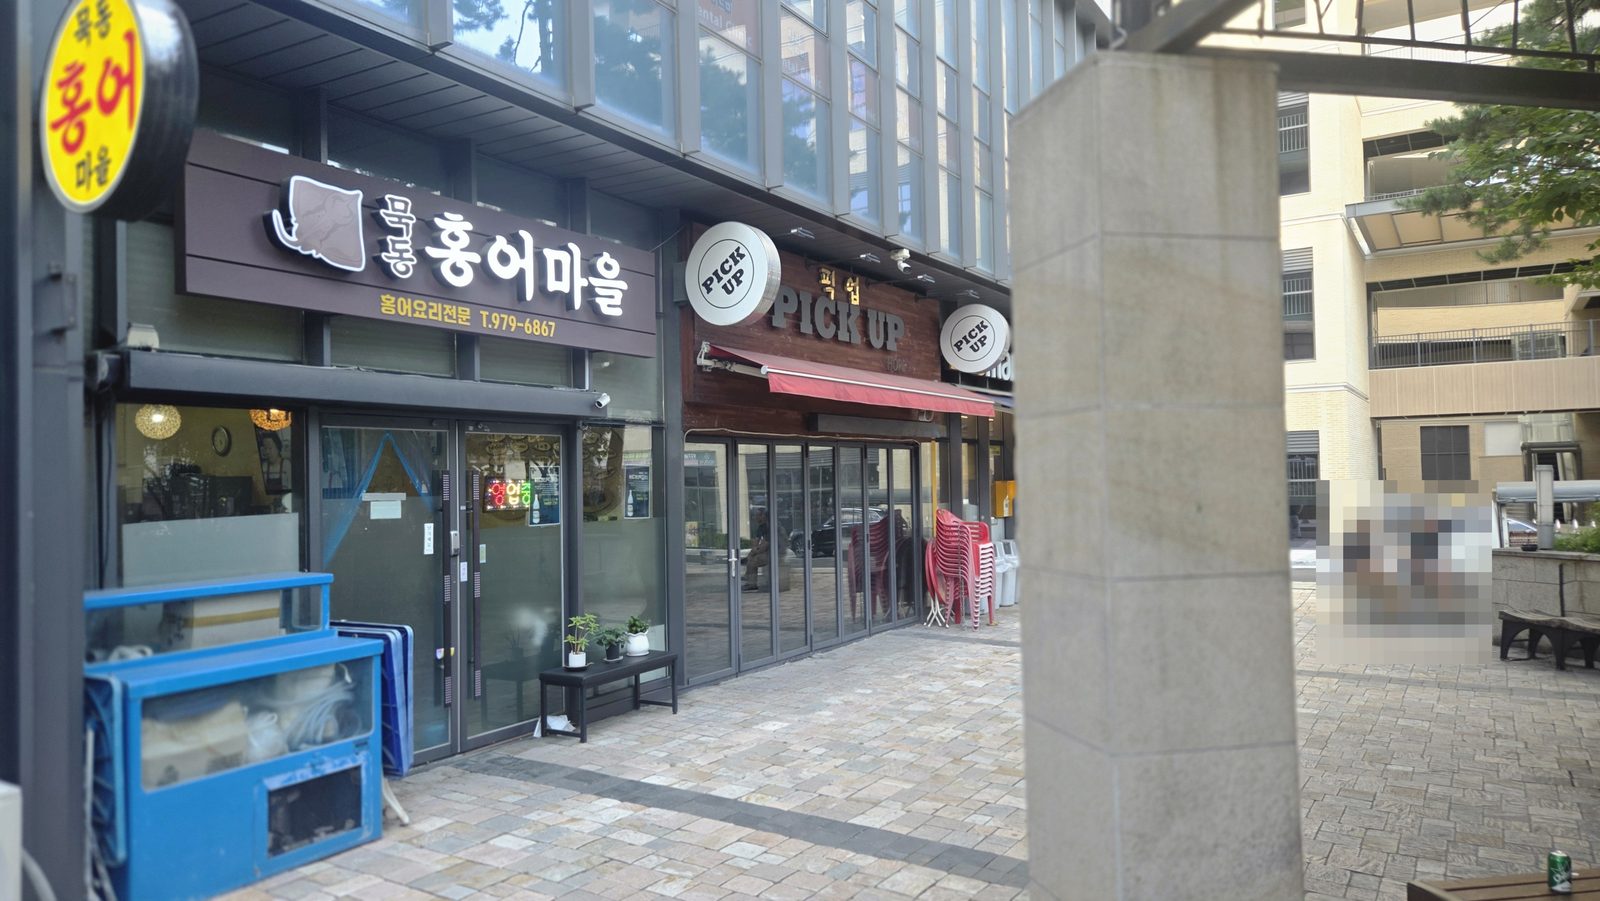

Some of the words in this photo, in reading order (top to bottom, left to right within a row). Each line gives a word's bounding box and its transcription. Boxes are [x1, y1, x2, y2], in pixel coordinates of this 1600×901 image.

[50, 28, 135, 155] 홍어
[75, 145, 111, 191] 마을
[379, 193, 417, 279] 묵동
[424, 211, 629, 316] 홍어마을
[701, 245, 746, 294] PICK
[721, 268, 744, 295] UP
[379, 293, 471, 326] 홍어요리전문
[479, 310, 556, 338] T.979-6867
[770, 284, 862, 345] PICK
[867, 307, 905, 352] UP
[953, 320, 989, 352] PICK
[969, 335, 988, 353] UP
[491, 482, 531, 506] 영업중
